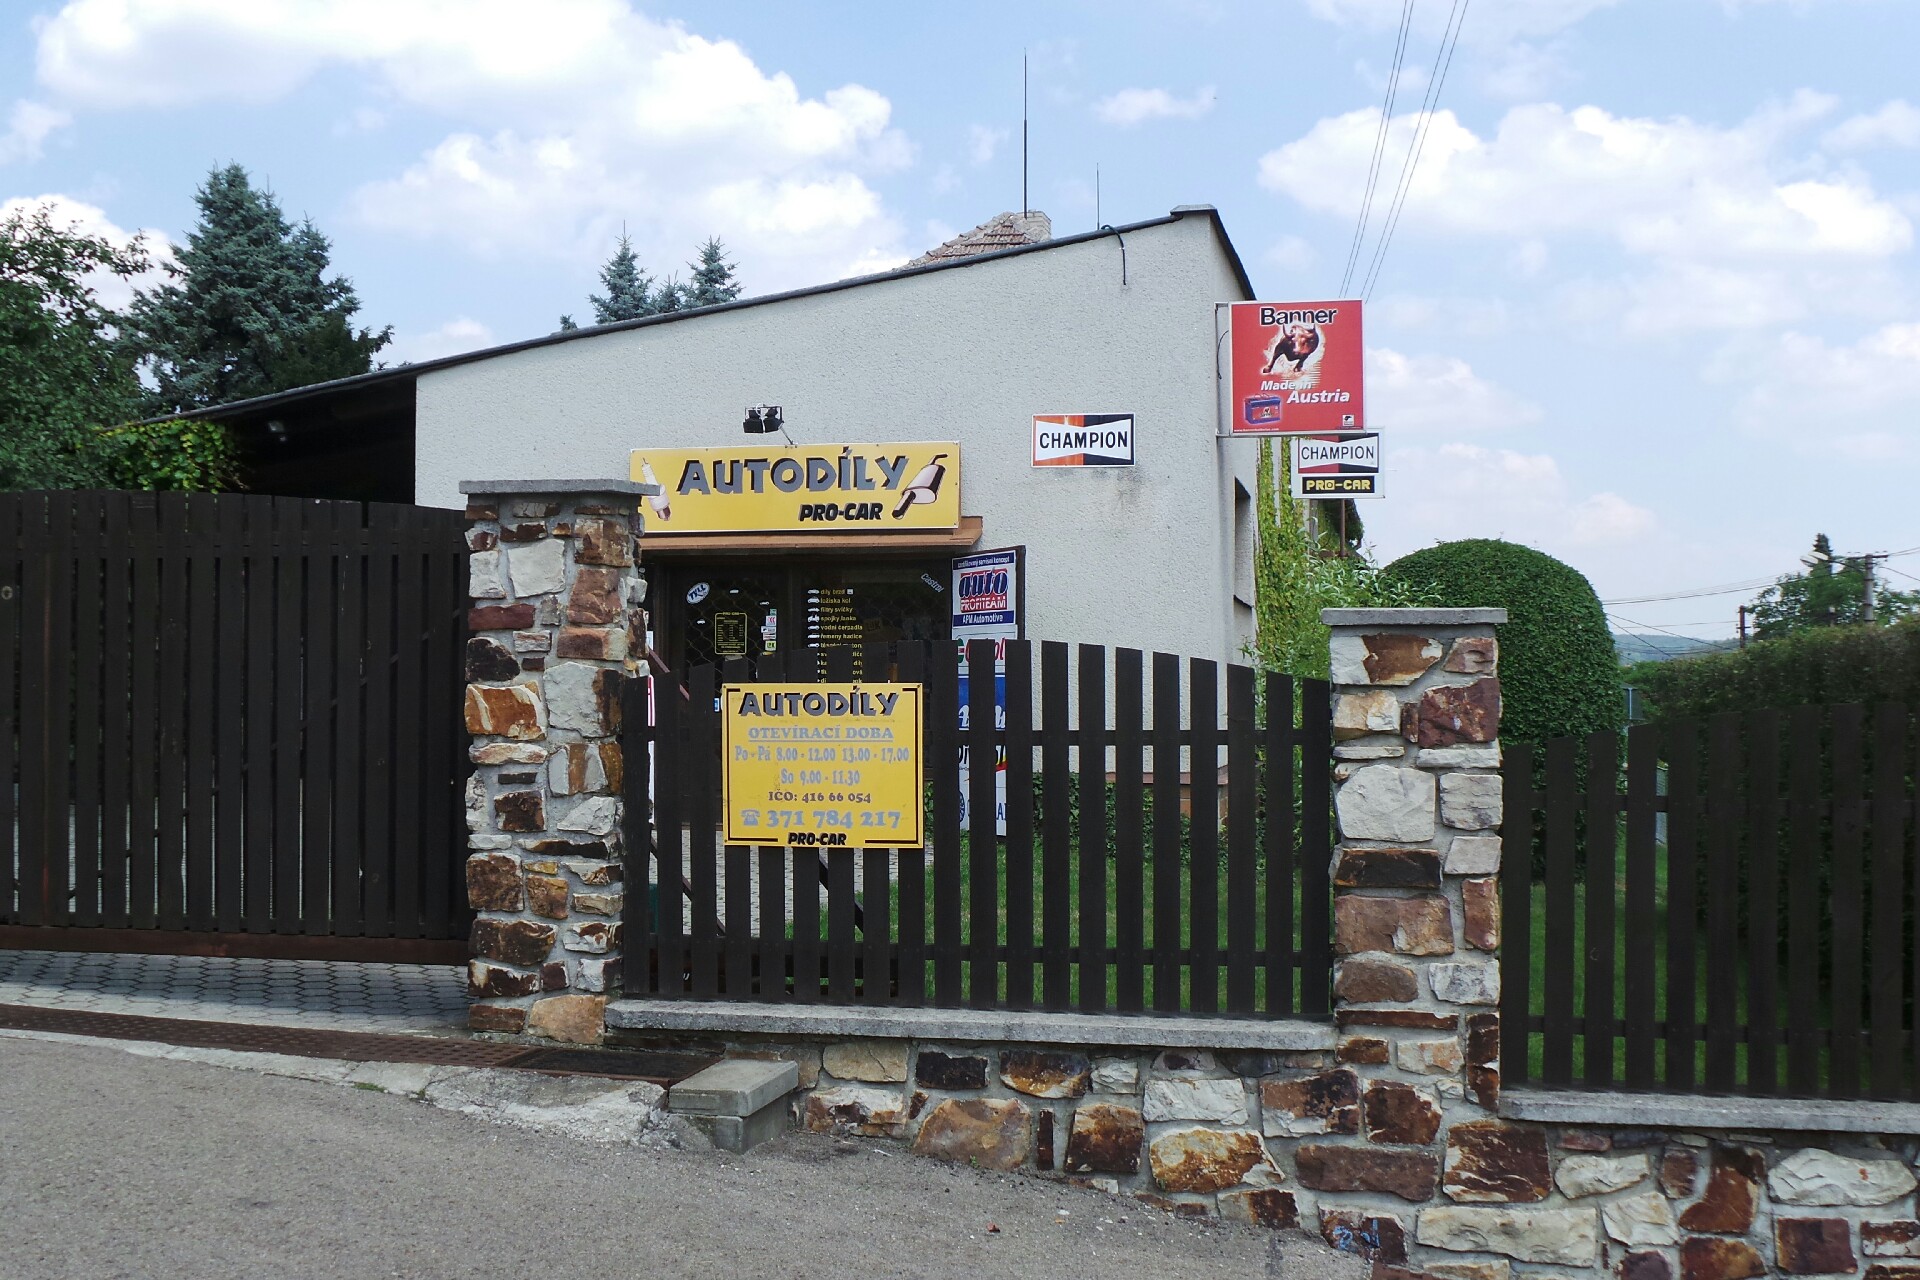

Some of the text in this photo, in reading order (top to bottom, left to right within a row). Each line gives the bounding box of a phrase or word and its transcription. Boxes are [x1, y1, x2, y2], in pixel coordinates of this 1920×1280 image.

[1260, 307, 1337, 326] Banner
[1261, 380, 1312, 390] Made in
[1286, 389, 1350, 404] Austria
[1040, 431, 1128, 448] CHAMPION
[1301, 446, 1374, 460] CHAMPION
[676, 446, 910, 495] AUTODÍLY
[1306, 480, 1370, 490] PRO-CAR
[798, 502, 883, 521] PRO-CAR
[959, 569, 1008, 598] auto
[961, 596, 1006, 610] PROFITEAM
[973, 613, 1003, 624] Automotive
[738, 685, 899, 716] AUTODÍLY
[748, 725, 894, 739] OTEVÍRACÍ DOBA
[734, 746, 748, 761] Po
[757, 746, 771, 761] Pá
[776, 748, 797, 761] 8.00
[808, 747, 835, 761] 12.00
[842, 747, 870, 763] 13.00
[881, 747, 909, 764] 17.00
[781, 768, 794, 784] So
[800, 770, 821, 786] 9.00
[832, 770, 860, 786] 11.30
[802, 792, 824, 803] 416
[829, 791, 844, 801] 66
[848, 792, 871, 804] 054
[766, 810, 900, 828] 371 784 217
[788, 832, 847, 846] PRO-CAR
